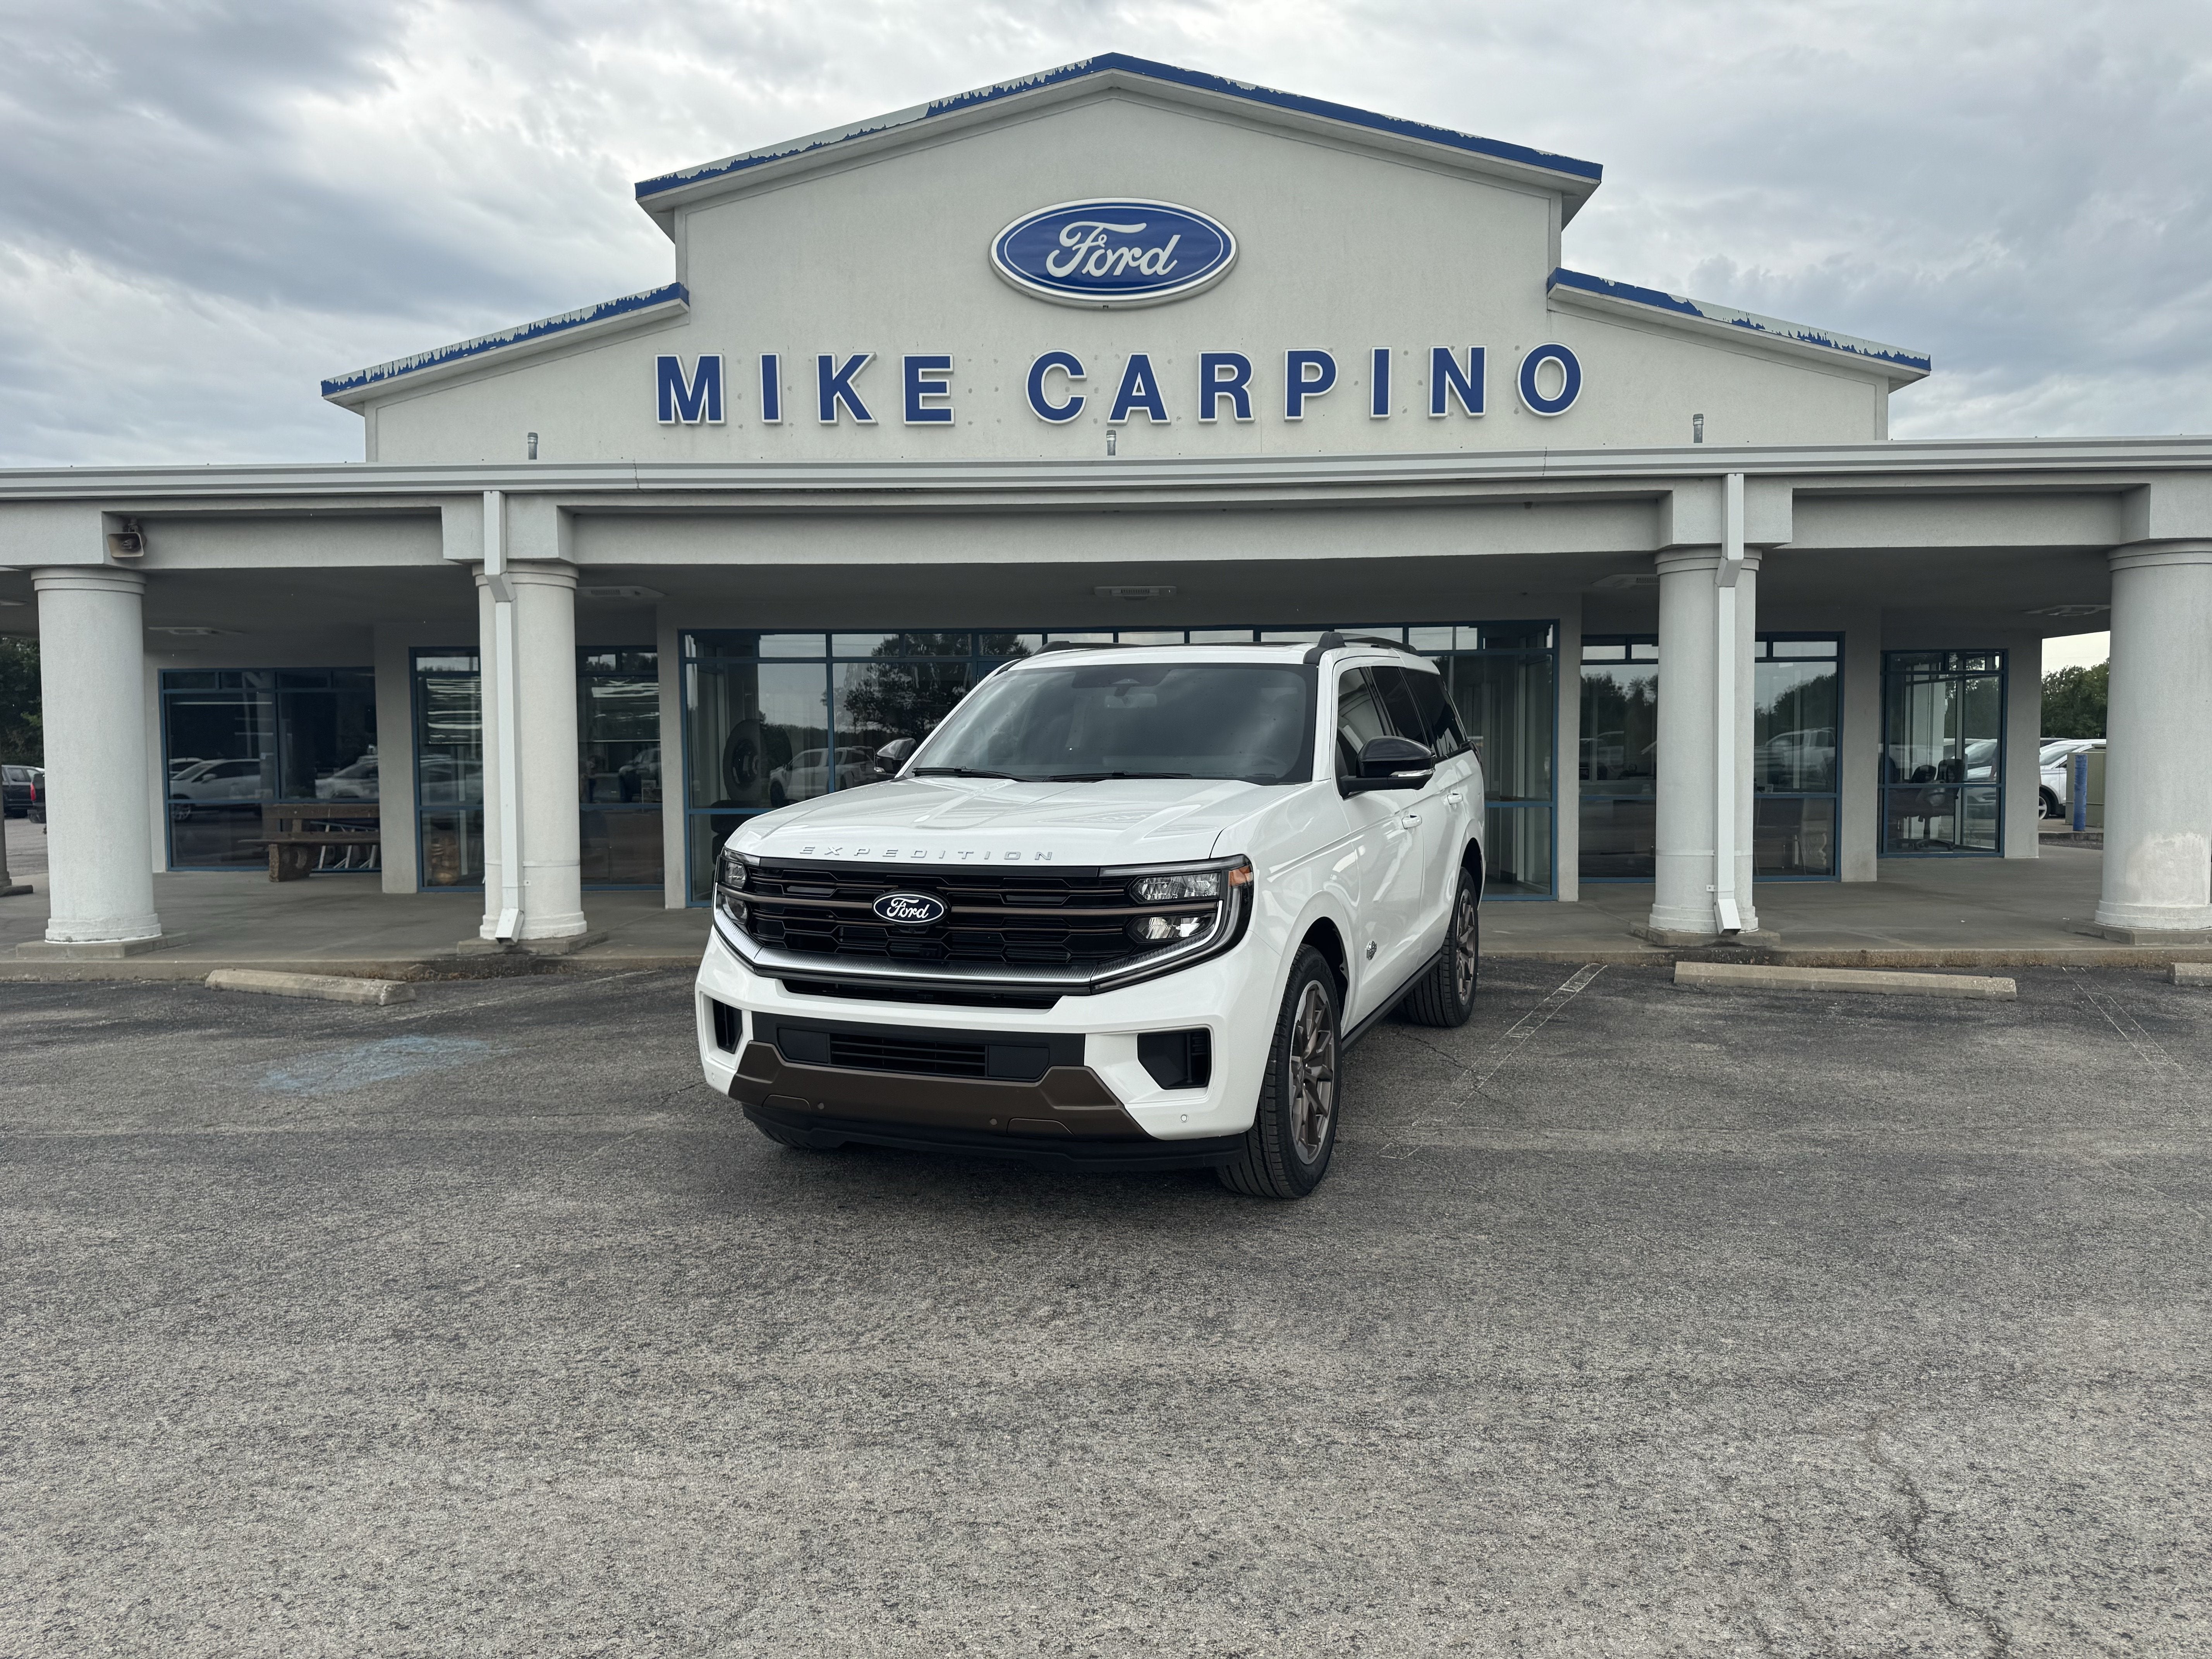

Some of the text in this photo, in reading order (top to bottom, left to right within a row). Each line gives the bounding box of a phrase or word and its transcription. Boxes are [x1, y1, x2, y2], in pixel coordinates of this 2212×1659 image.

[1046, 222, 1181, 278] Ford
[655, 342, 1583, 426] MIKE CARPINO
[799, 846, 1053, 860] EXPEDITION
[886, 897, 930, 919] Ford
